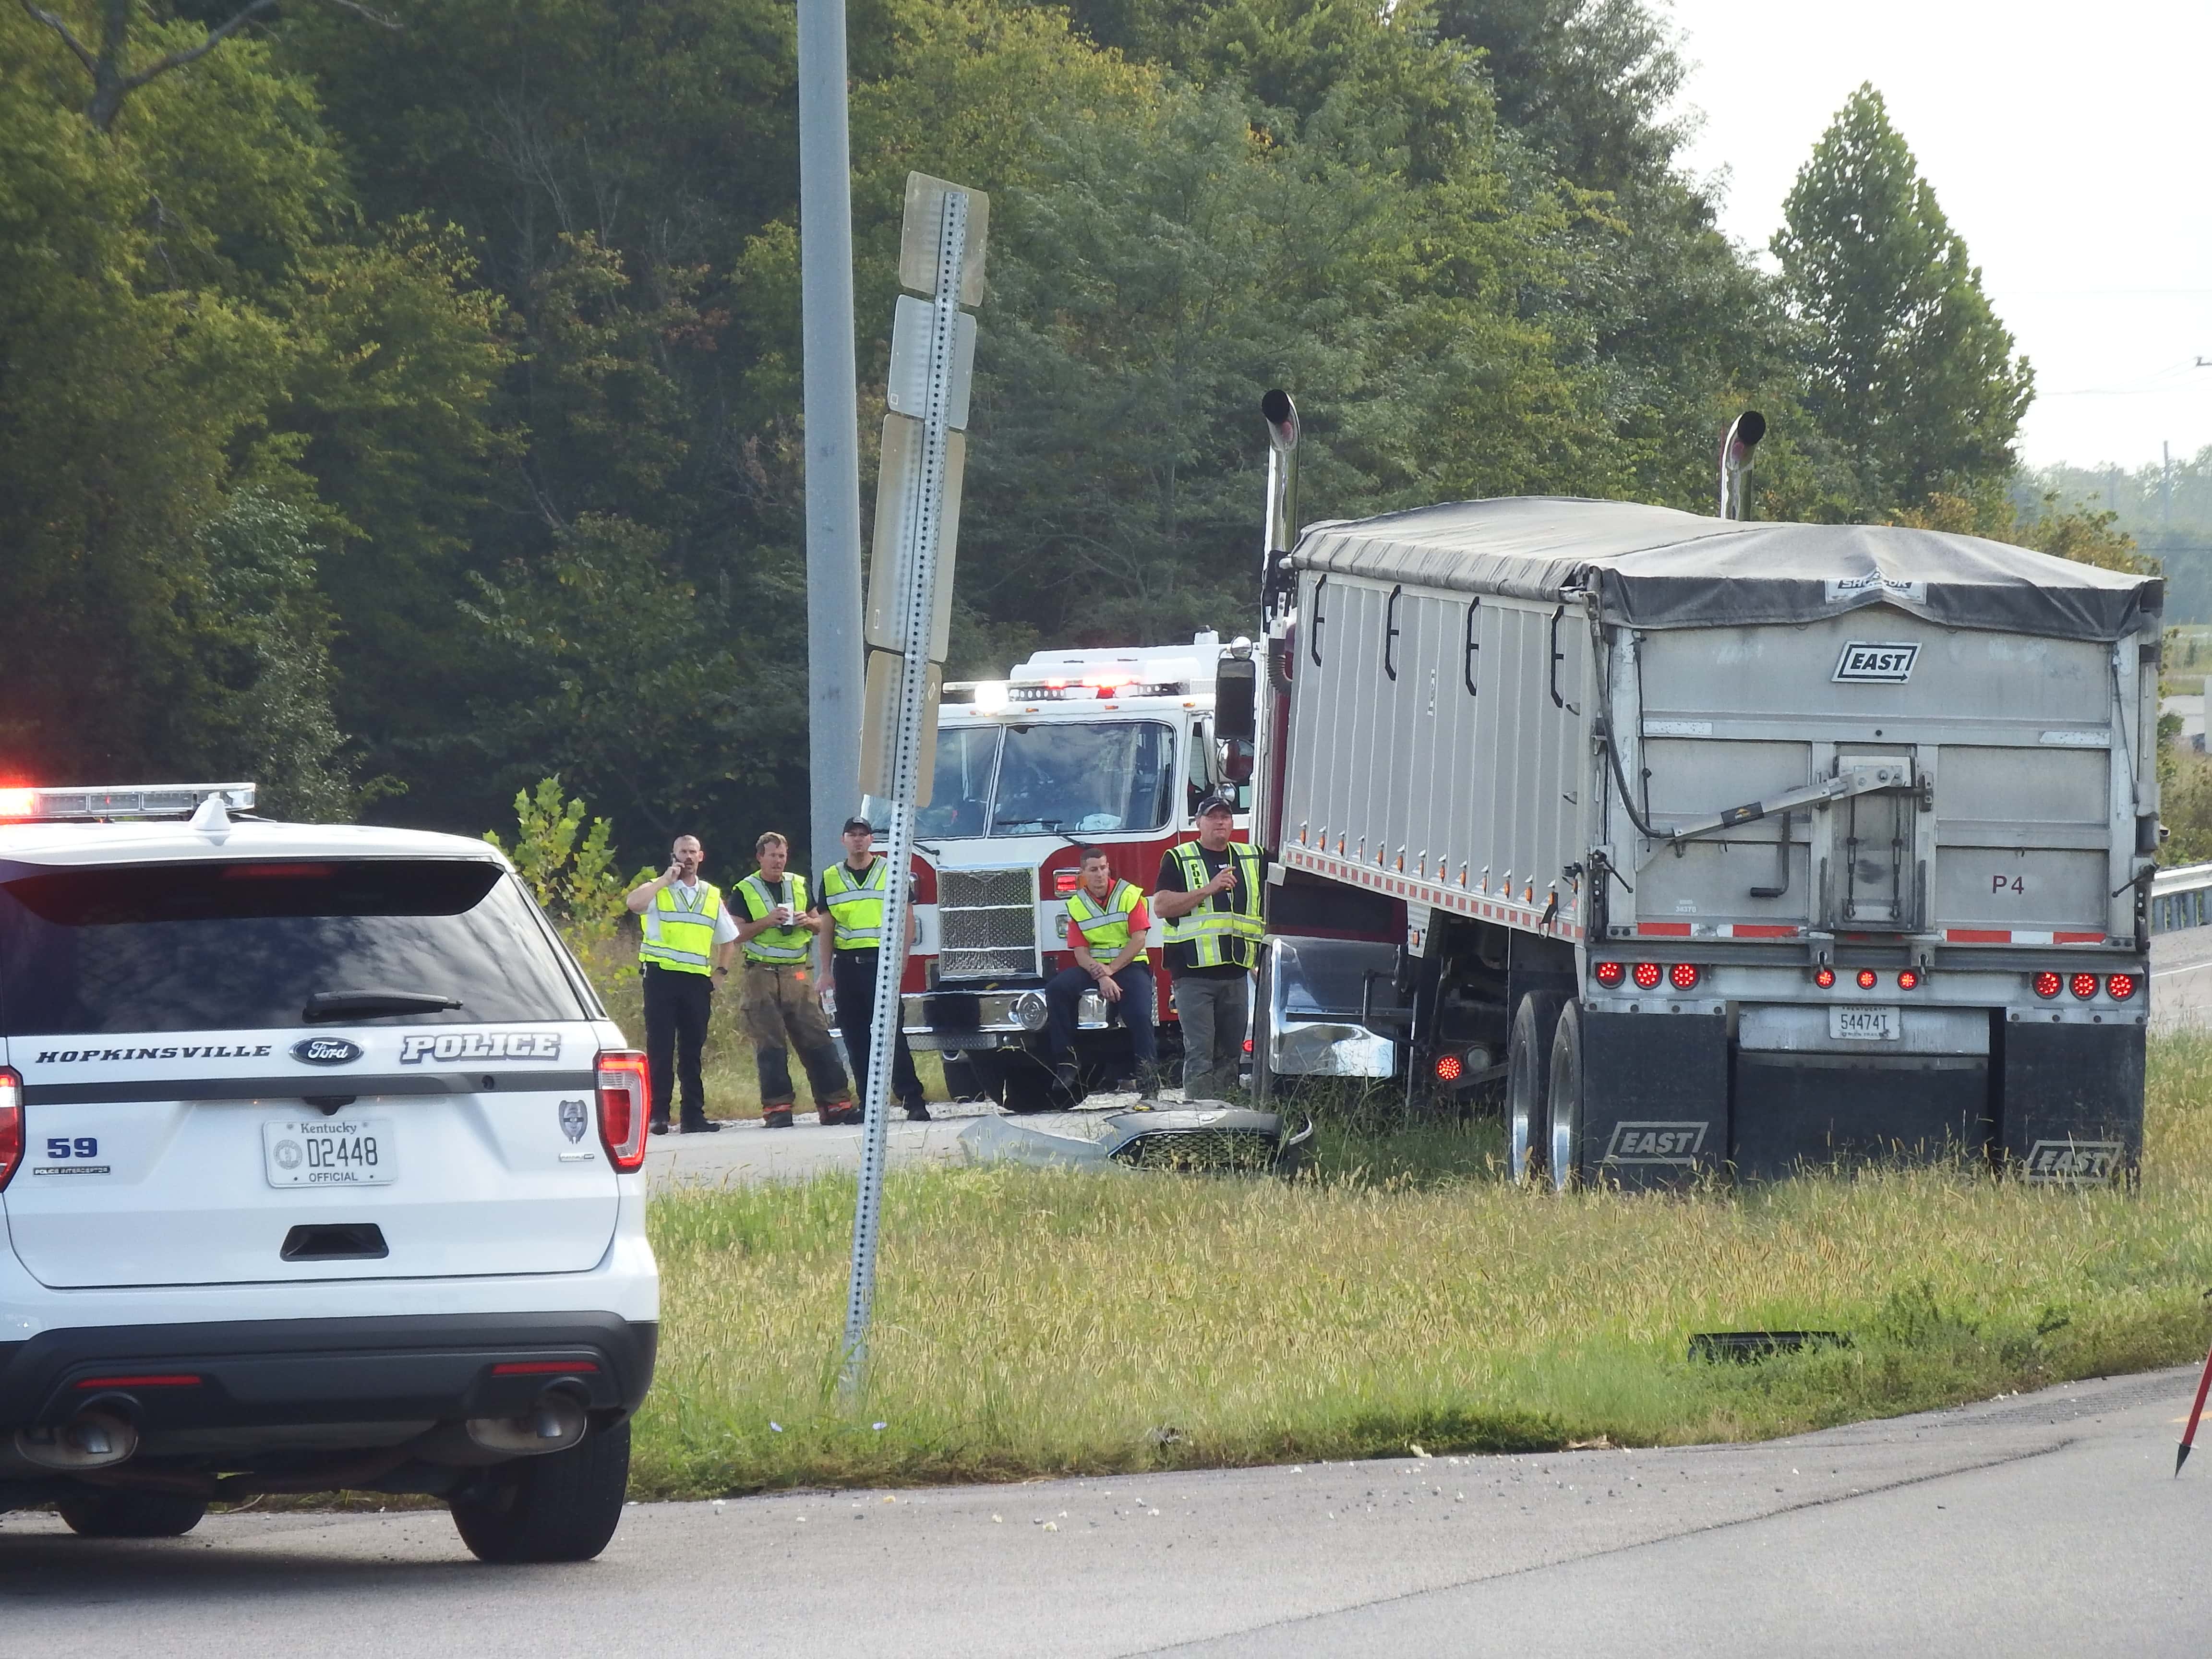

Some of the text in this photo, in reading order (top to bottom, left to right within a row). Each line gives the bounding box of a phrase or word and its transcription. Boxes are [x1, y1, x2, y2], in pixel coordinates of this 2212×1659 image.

[1850, 653, 1907, 671] EAST
[1190, 864, 1205, 908] POLE
[1840, 1014, 1887, 1030] 54474T
[36, 1045, 272, 1063] HOPKINSVILLE
[308, 1041, 348, 1059] Ford
[399, 1033, 561, 1064] POLICE
[301, 1122, 357, 1134] Kentucky
[47, 1138, 97, 1158] 59
[307, 1137, 378, 1167] D2448
[1620, 1132, 1694, 1153] EAST
[2037, 1151, 2110, 1172] EAST
[309, 1172, 359, 1182] OFFICIAL
